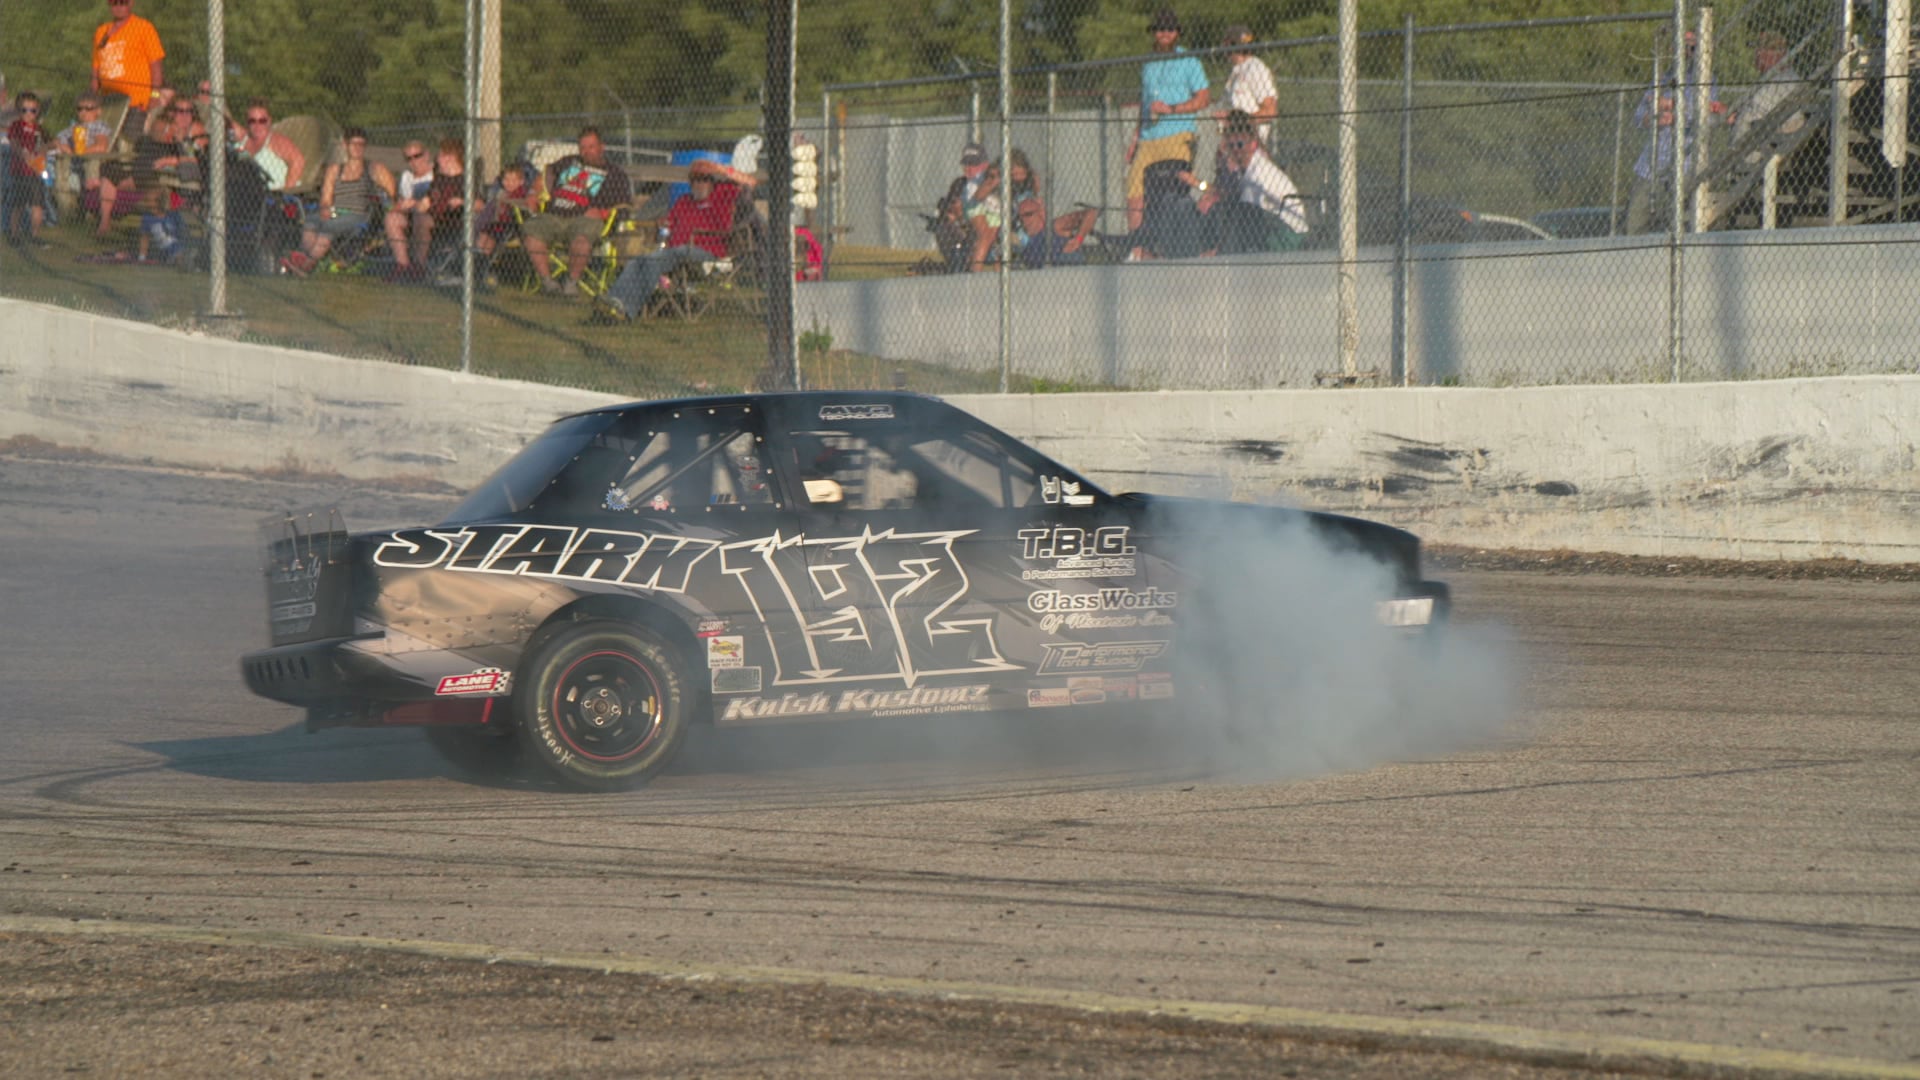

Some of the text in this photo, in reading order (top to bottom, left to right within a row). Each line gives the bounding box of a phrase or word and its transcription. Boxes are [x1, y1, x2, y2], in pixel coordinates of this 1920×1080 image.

[1017, 526, 1136, 559] T.B.G.
[373, 525, 722, 593] STARK
[1056, 557, 1135, 569] Advanced Tuning
[1031, 568, 1091, 580] Performance
[1091, 567, 1136, 578] Solutions
[1027, 586, 1177, 613] GlassWorks
[444, 675, 495, 687] LANE
[872, 705, 931, 718] Automotive
[537, 707, 575, 766] Hoosier
